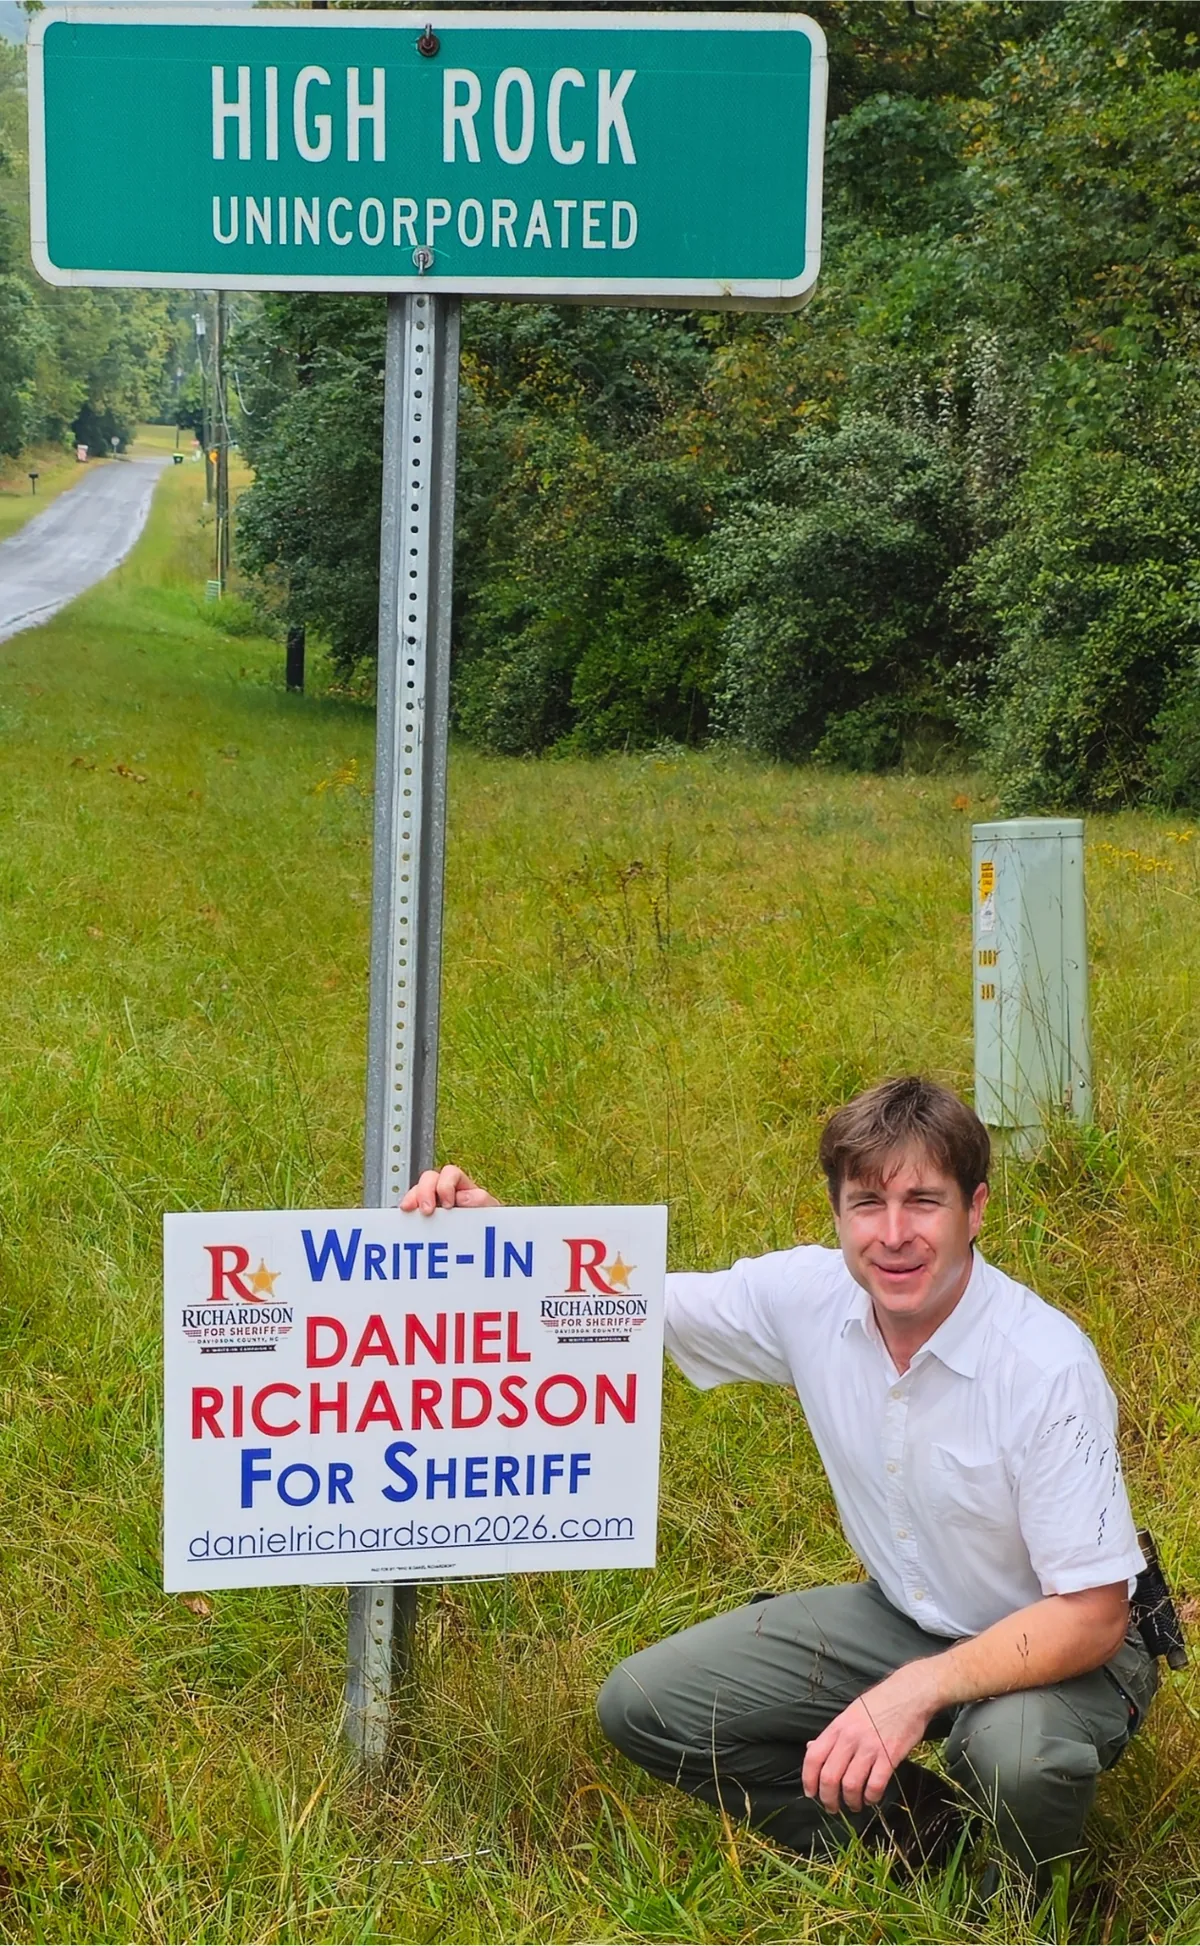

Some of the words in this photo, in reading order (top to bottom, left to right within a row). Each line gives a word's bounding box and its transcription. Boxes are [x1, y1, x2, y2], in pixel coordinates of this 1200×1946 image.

[212, 66, 386, 162] HIGH
[443, 67, 637, 165] ROCK
[212, 196, 638, 250] UNINCORPORATED
[203, 1245, 268, 1303] R
[562, 1239, 623, 1295] R
[181, 1307, 294, 1329] RICHARDSON
[203, 1328, 226, 1337] FOR
[230, 1326, 276, 1336] SHERIFF
[540, 1299, 648, 1319] RICHARDSON
[560, 1319, 582, 1327] FOR
[586, 1317, 631, 1327] SHERIFF
[306, 1311, 531, 1369] DANIEL
[191, 1373, 637, 1439] RICHARDSON
[239, 1446, 355, 1510] FOR
[381, 1440, 592, 1504] SHERIFF
[188, 1514, 635, 1558] danielrichardson2026.com
